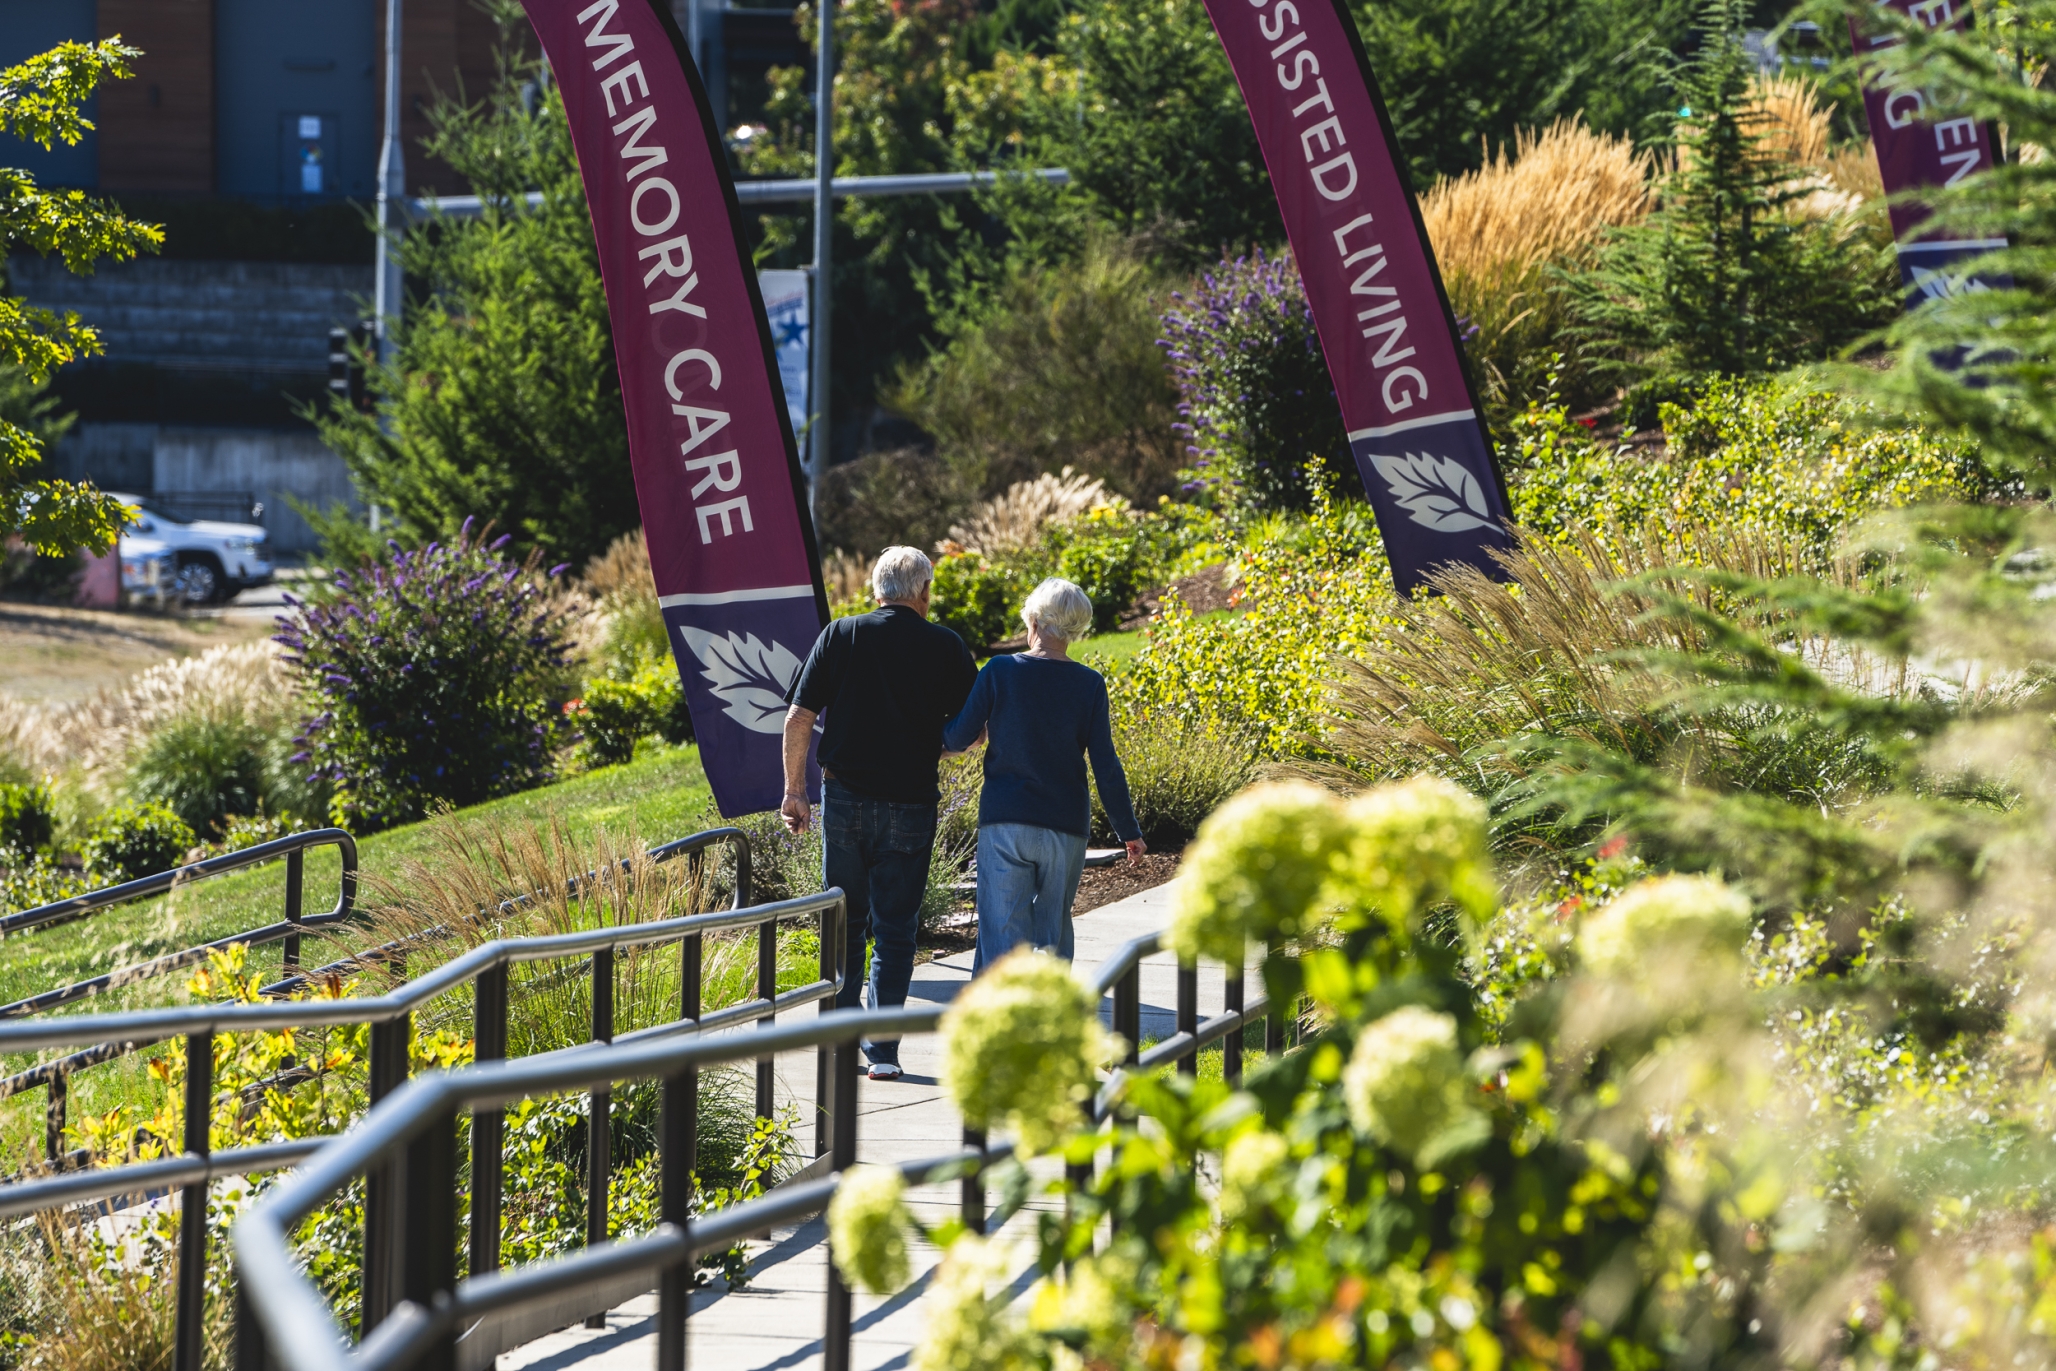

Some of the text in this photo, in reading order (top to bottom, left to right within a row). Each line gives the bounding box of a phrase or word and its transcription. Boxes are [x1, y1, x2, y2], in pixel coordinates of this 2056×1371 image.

[576, 0, 754, 545] MEMORY CARE
[1248, 0, 1428, 415] SISTED LIVING
